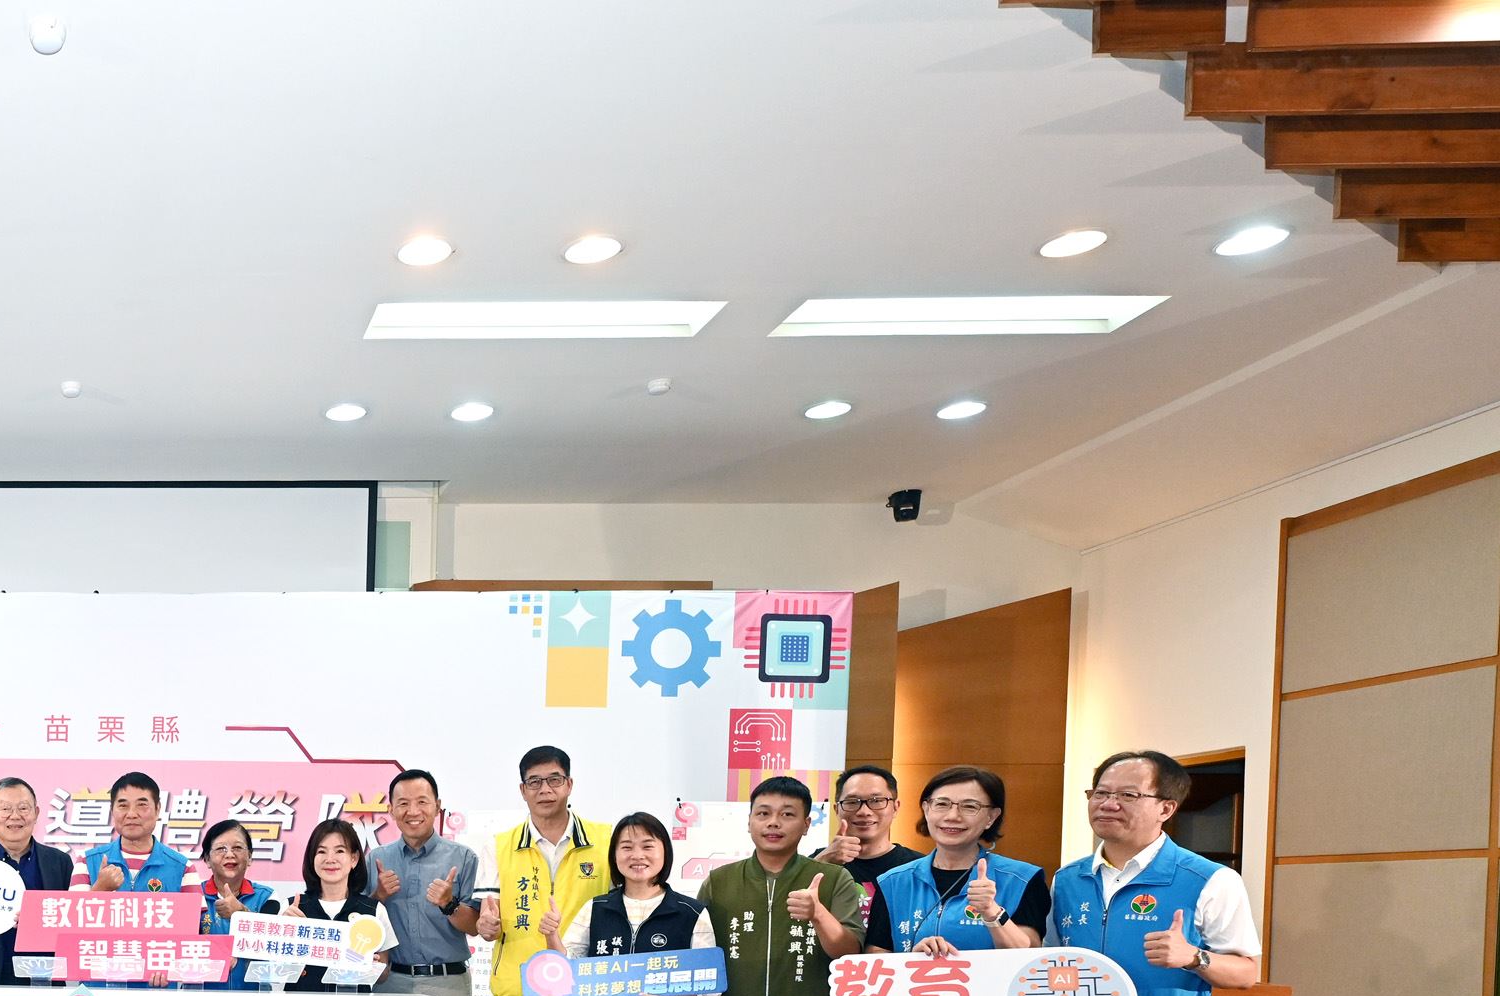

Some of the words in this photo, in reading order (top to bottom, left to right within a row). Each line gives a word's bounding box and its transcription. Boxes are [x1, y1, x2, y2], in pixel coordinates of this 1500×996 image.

[44, 715, 181, 744] 苗栗縣
[41, 897, 174, 929] 數位科技
[238, 919, 342, 942] 苗栗教育新亮點
[236, 937, 341, 960] 小小科技夢起點
[578, 955, 679, 976] 跟著AI一起玩
[1053, 973, 1072, 984] AI
